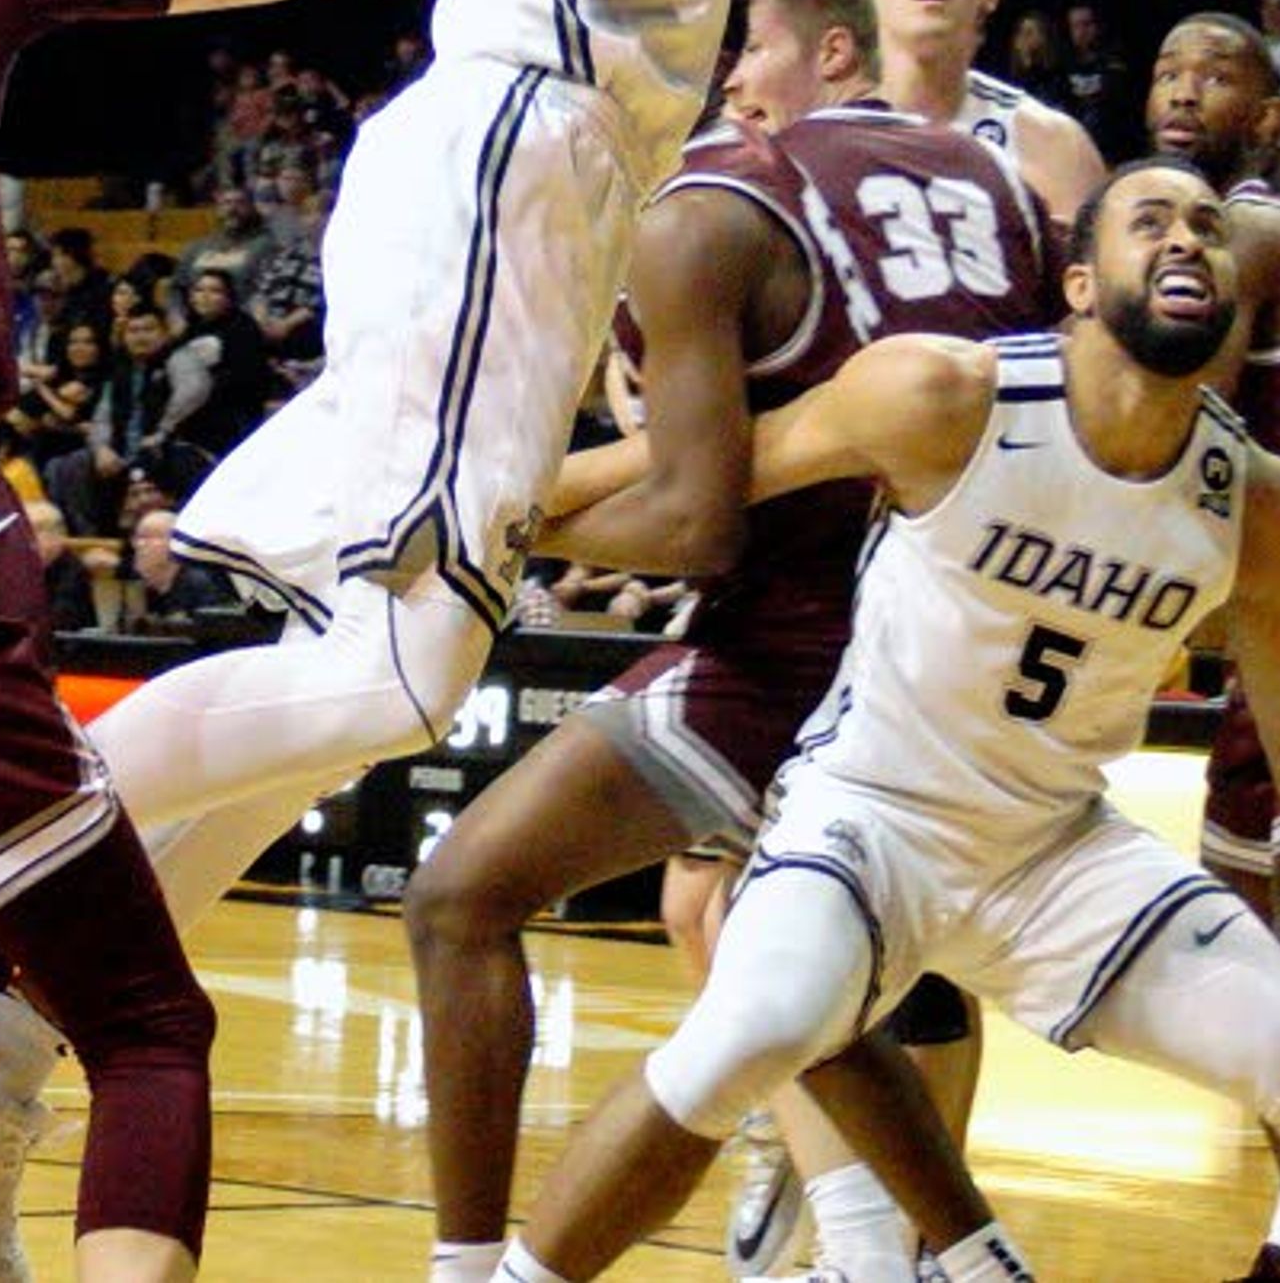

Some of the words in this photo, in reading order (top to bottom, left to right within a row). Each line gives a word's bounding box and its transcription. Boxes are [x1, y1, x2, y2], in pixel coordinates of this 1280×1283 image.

[856, 176, 1013, 301] 33
[968, 523, 1199, 631] IDAHO
[1002, 623, 1089, 722] 5
